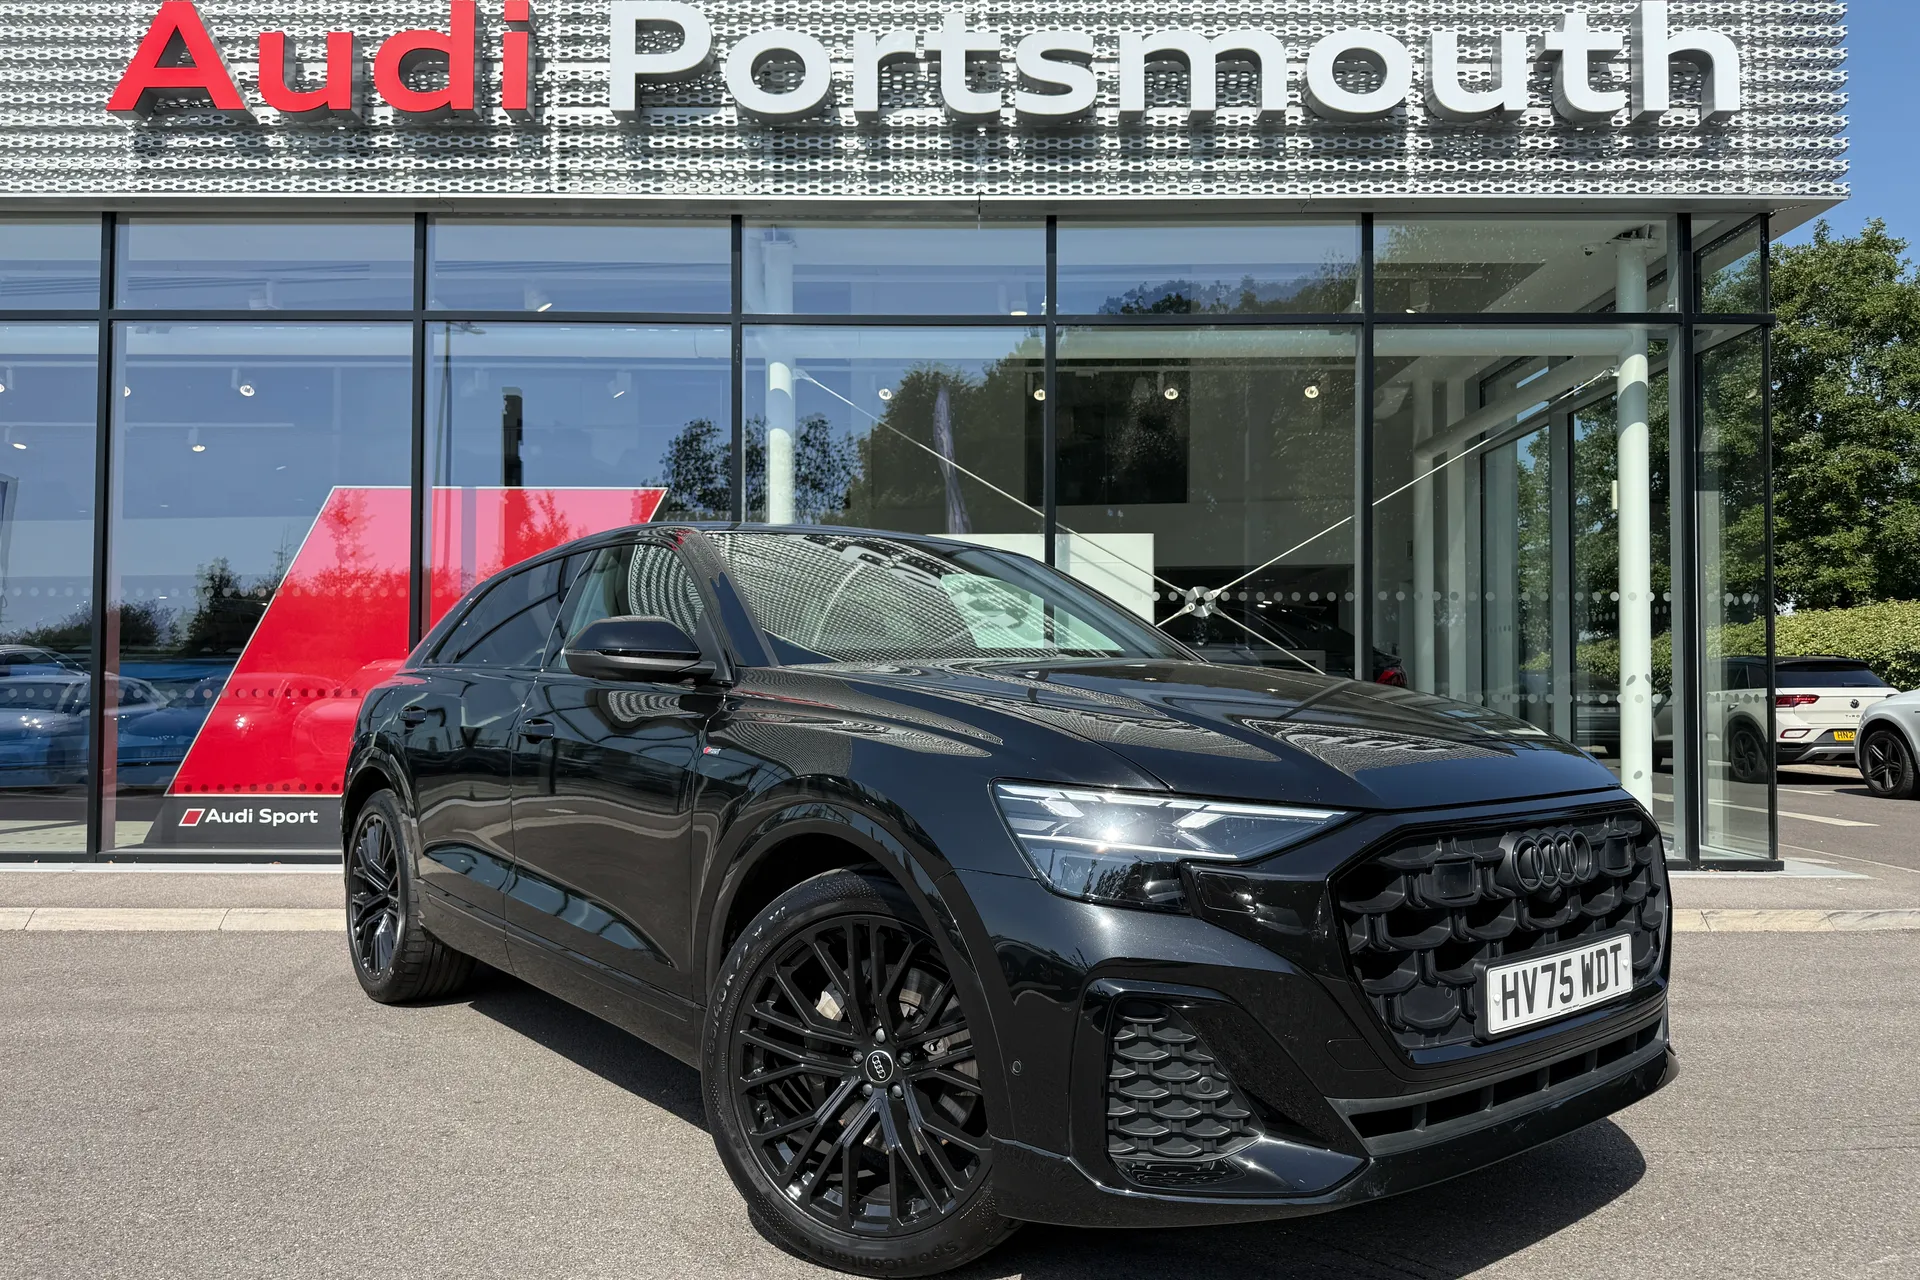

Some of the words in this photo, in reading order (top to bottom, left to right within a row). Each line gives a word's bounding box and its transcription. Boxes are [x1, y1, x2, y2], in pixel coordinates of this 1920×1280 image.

[105, 0, 530, 113] Audi
[609, 0, 1741, 117] Portsmouth
[205, 808, 253, 823] Audi
[259, 808, 319, 827] Sport
[1501, 958, 1573, 1021] HV75
[1580, 943, 1622, 998] WDT
